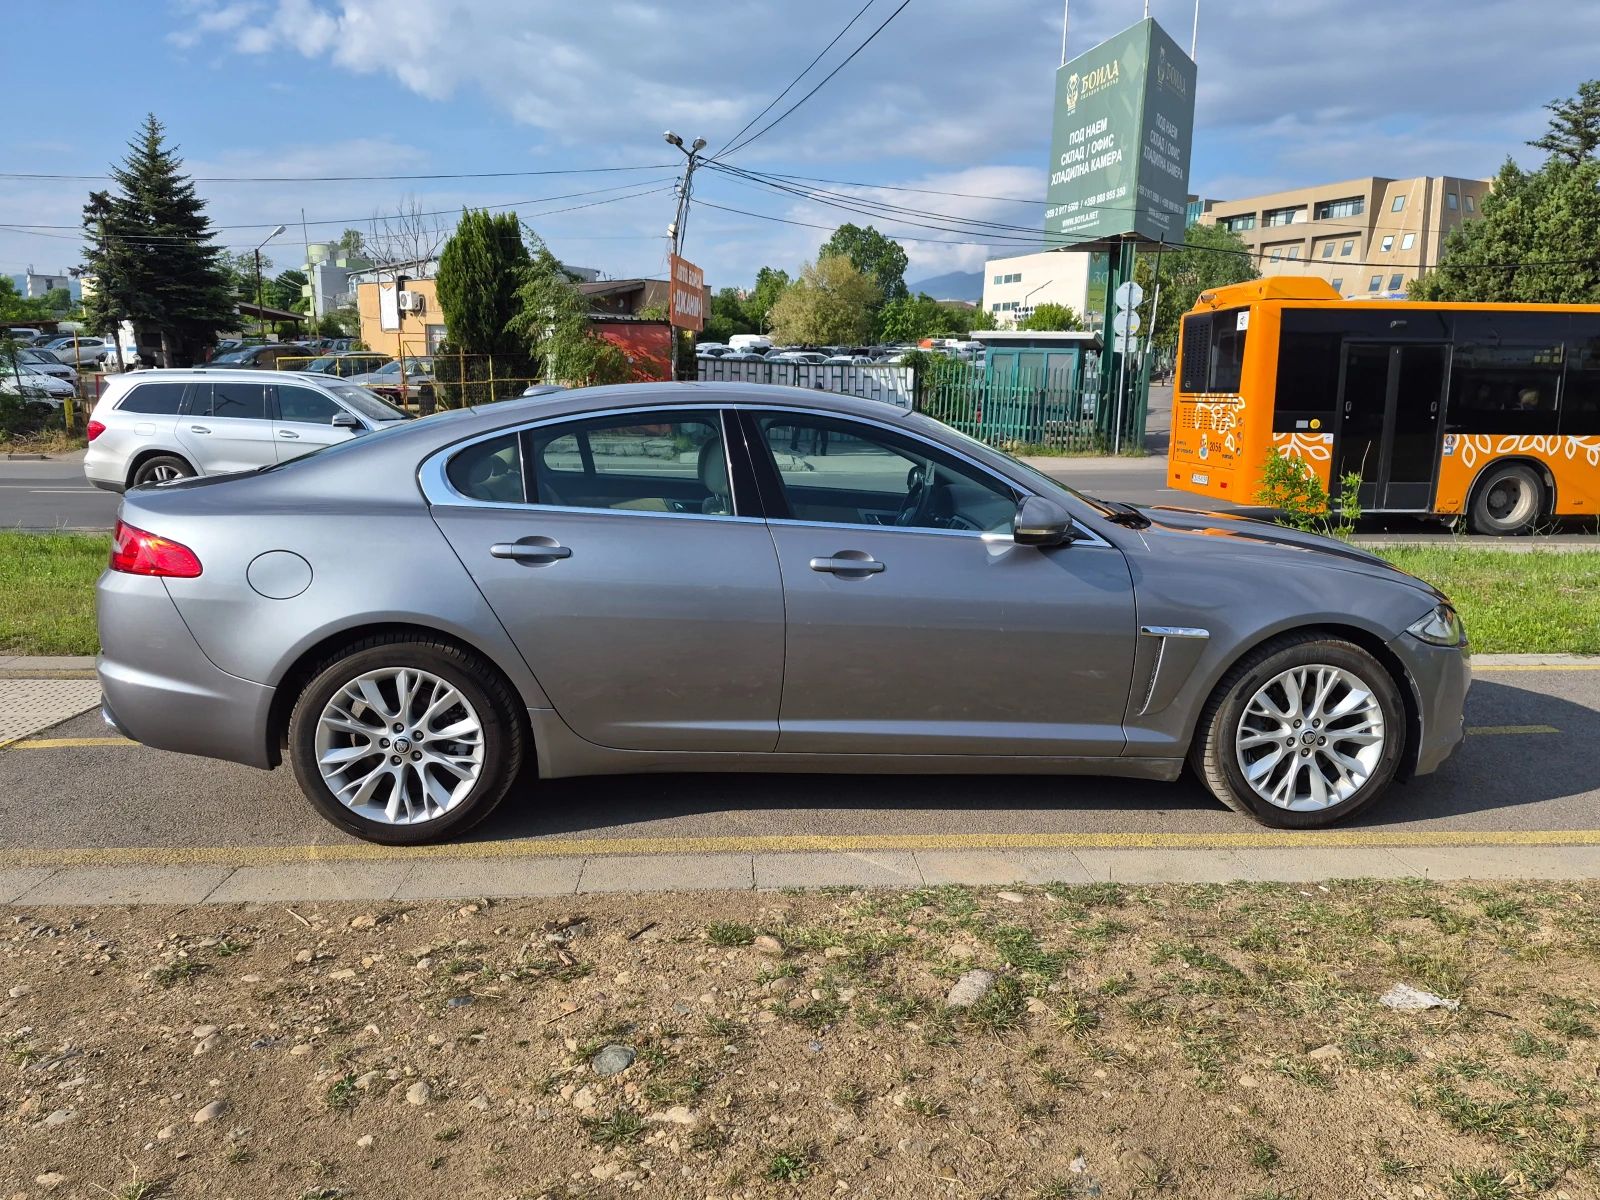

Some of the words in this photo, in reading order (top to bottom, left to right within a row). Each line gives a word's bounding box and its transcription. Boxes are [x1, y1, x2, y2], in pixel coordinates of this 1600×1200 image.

[1069, 127, 1085, 146] ПОД
[1086, 117, 1108, 138] НАЕМ
[1061, 145, 1085, 166] СКЛАД
[1091, 133, 1115, 154] ОФИС
[1050, 161, 1090, 186] ХЛАДИЛНА
[1090, 148, 1123, 172] КАМЕРА
[1116, 185, 1127, 198] 350
[1062, 210, 1099, 228] WWW.BOYLA.NET
[675, 289, 699, 317] ДЖАНИ
[1209, 441, 1222, 453] 2056
